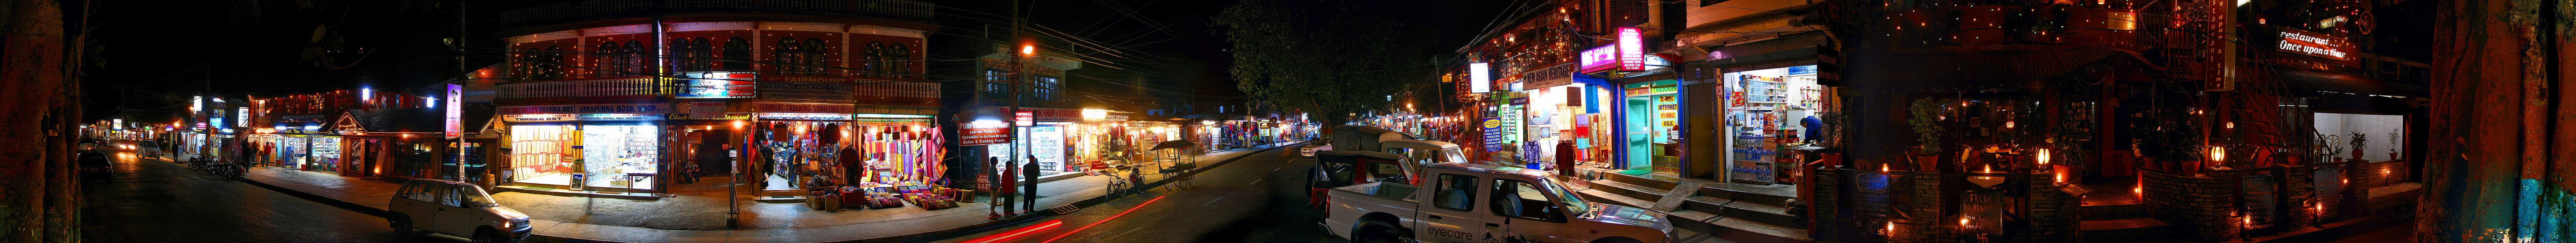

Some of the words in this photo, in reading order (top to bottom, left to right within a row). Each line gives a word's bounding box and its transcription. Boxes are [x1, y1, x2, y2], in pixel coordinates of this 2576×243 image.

[2280, 40, 2302, 52] Once
[2303, 46, 2323, 54] upon
[2330, 48, 2346, 58] time
[1582, 50, 1593, 67] MS
[1527, 72, 1535, 84] NEW
[1536, 69, 1548, 82] ASIAN
[1548, 64, 1570, 80] HERITAGE
[1653, 84, 1677, 93] TREKKIN
[759, 103, 783, 111] FAIRMOUNT
[1059, 110, 1082, 118] STATIONERS
[1970, 193, 1992, 203] FRESH
[1428, 227, 1473, 241] eyecare
